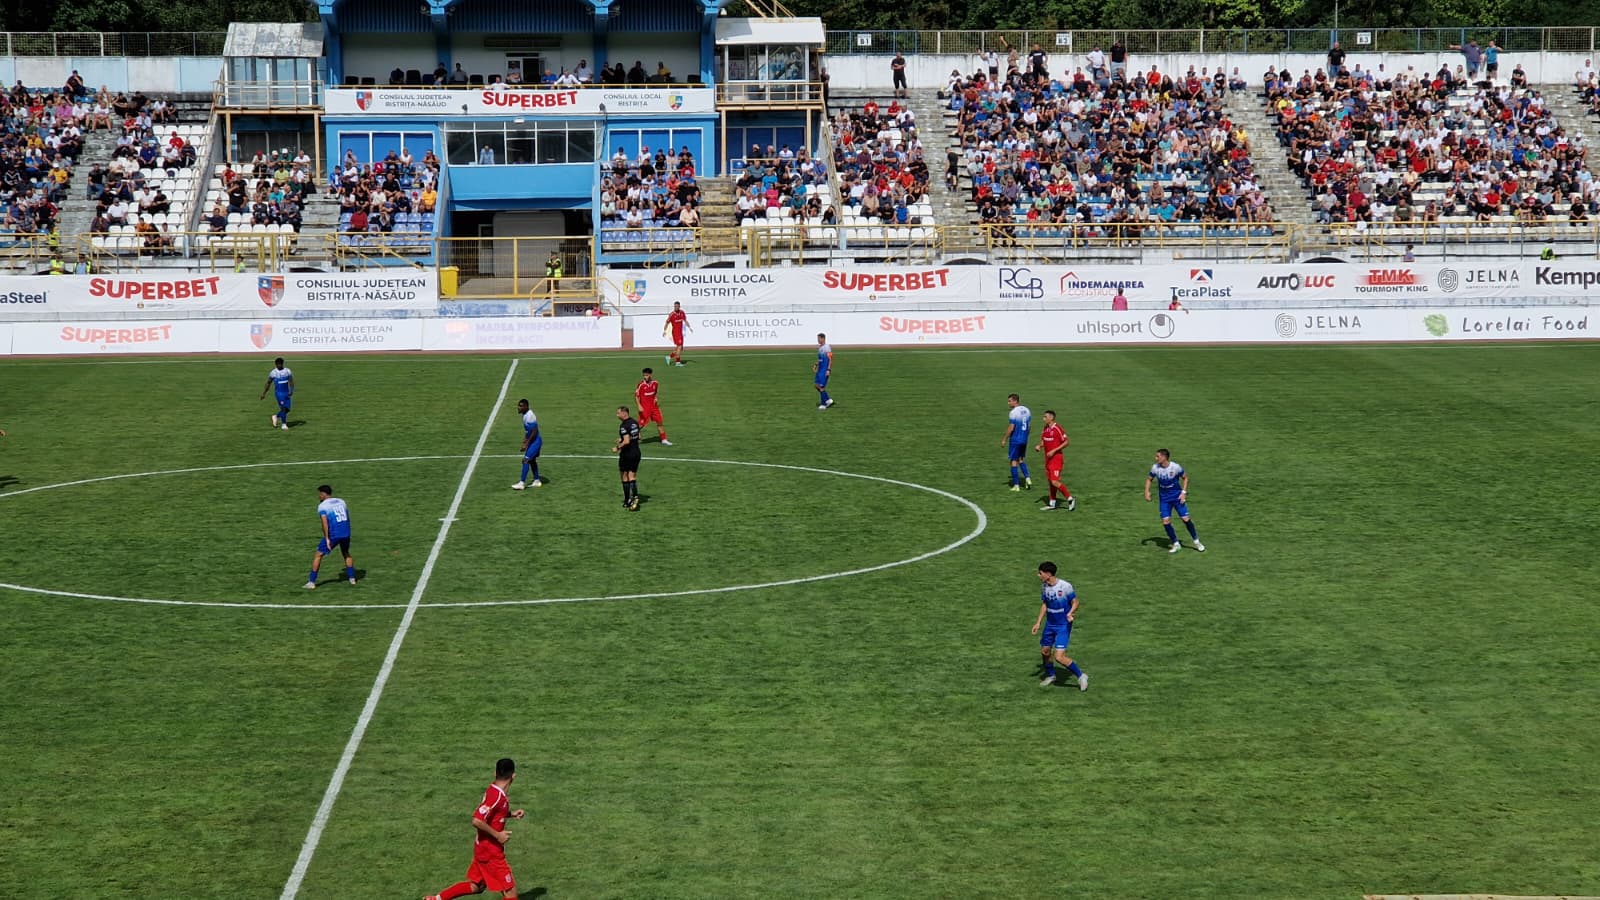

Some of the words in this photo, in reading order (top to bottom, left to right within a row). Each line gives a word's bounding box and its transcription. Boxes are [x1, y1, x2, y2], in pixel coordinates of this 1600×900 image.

[482, 90, 578, 108] SUPERBET
[663, 274, 729, 284] CONSILIUL
[733, 273, 775, 284] LOCAL
[823, 268, 950, 292] SUPERBET
[999, 267, 1044, 299] RCB
[1256, 273, 1300, 291] AUTO
[1304, 275, 1336, 288] LUC
[1369, 269, 1414, 284] TMK
[1465, 269, 1520, 283] JELNA
[89, 276, 220, 299] SUPERBET
[296, 279, 360, 289] CONSILIUL
[363, 279, 426, 291] JUDEȚEAN
[1068, 280, 1145, 289] INDEMANAREA
[1170, 286, 1232, 297] TeraPlast
[691, 287, 747, 299] BISTRIȚA
[702, 319, 762, 328] CONSILIUL
[765, 318, 803, 327] LOCAL
[879, 315, 986, 334] SUPERBET
[1076, 320, 1143, 336] uhlsport
[1304, 315, 1362, 328] JELNA
[1462, 316, 1531, 332] Lorelai
[1541, 315, 1588, 331] Food
[60, 325, 172, 344] SUPERBET
[283, 326, 336, 335] CONSILIUL
